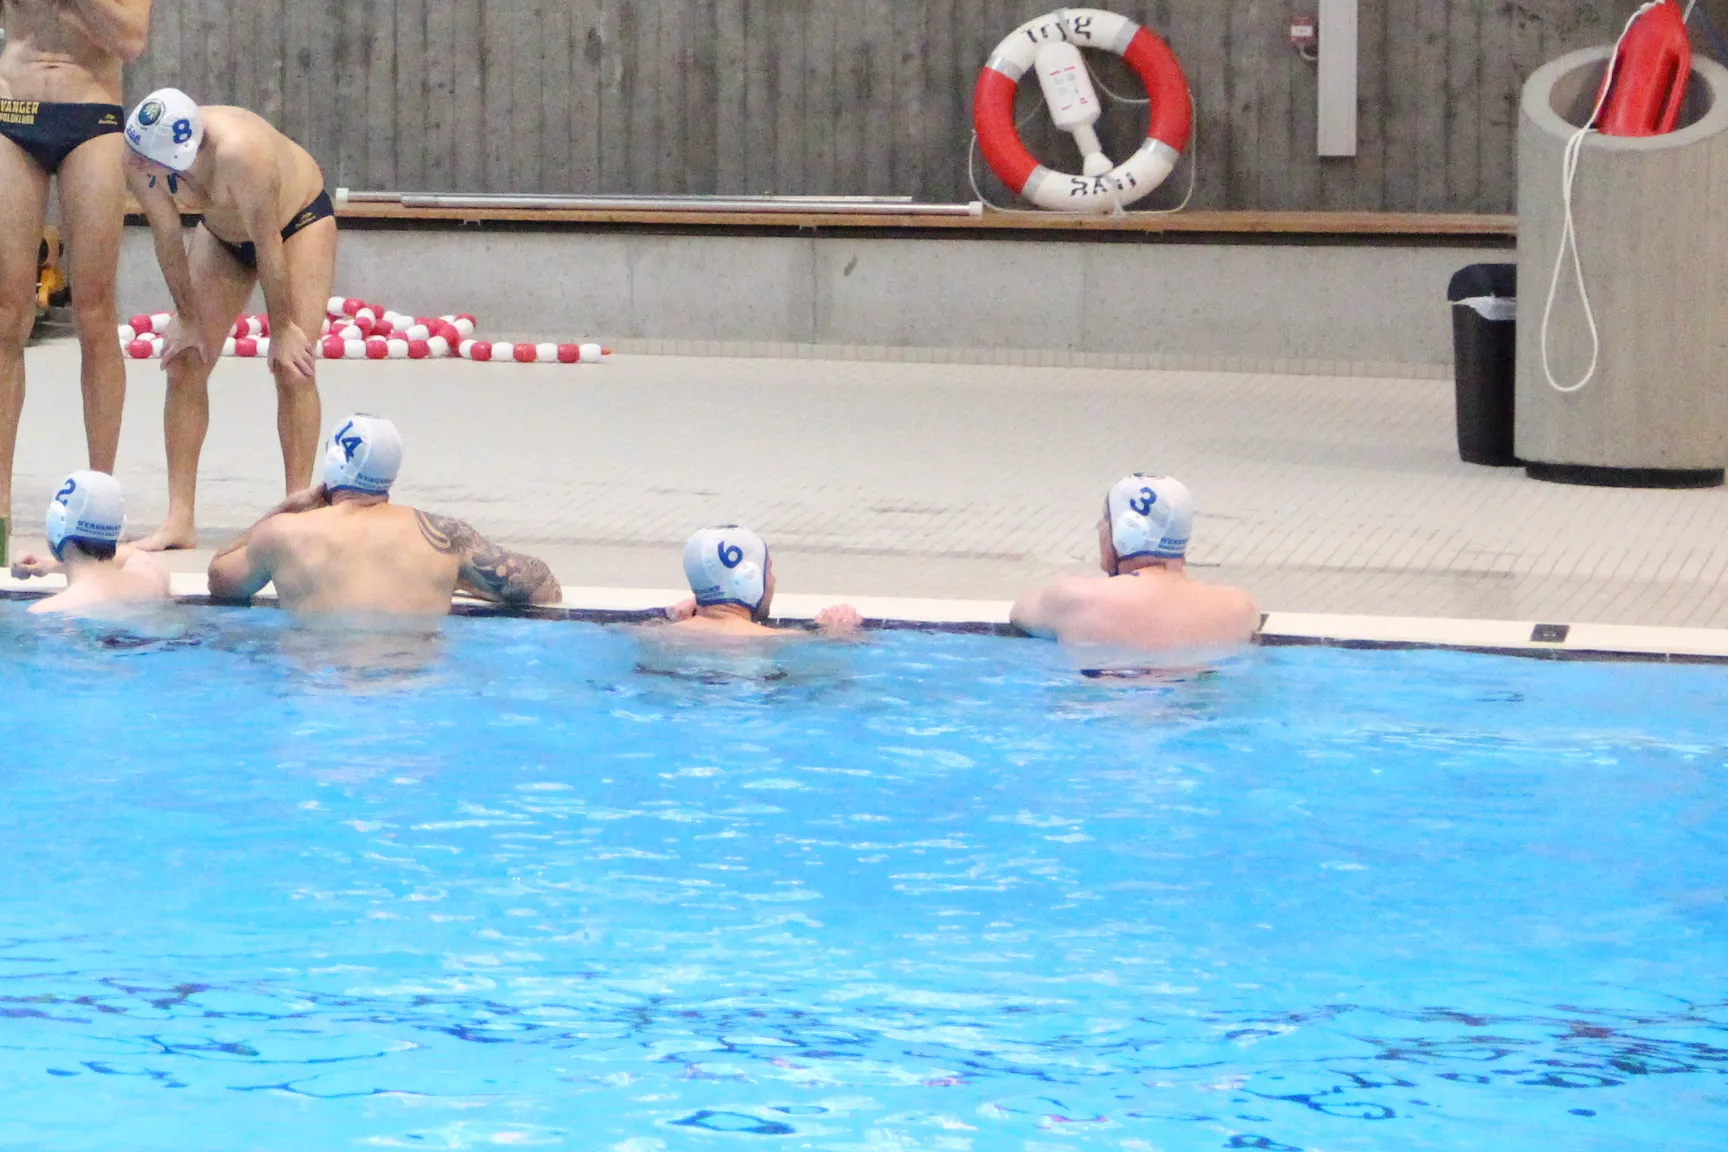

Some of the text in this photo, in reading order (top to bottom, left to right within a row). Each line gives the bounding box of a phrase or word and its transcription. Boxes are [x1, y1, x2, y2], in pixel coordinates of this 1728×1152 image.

[173, 119, 192, 144] 8
[335, 421, 362, 463] 14
[55, 478, 76, 507] 2
[1130, 487, 1157, 516] 3
[717, 540, 744, 569] 6
